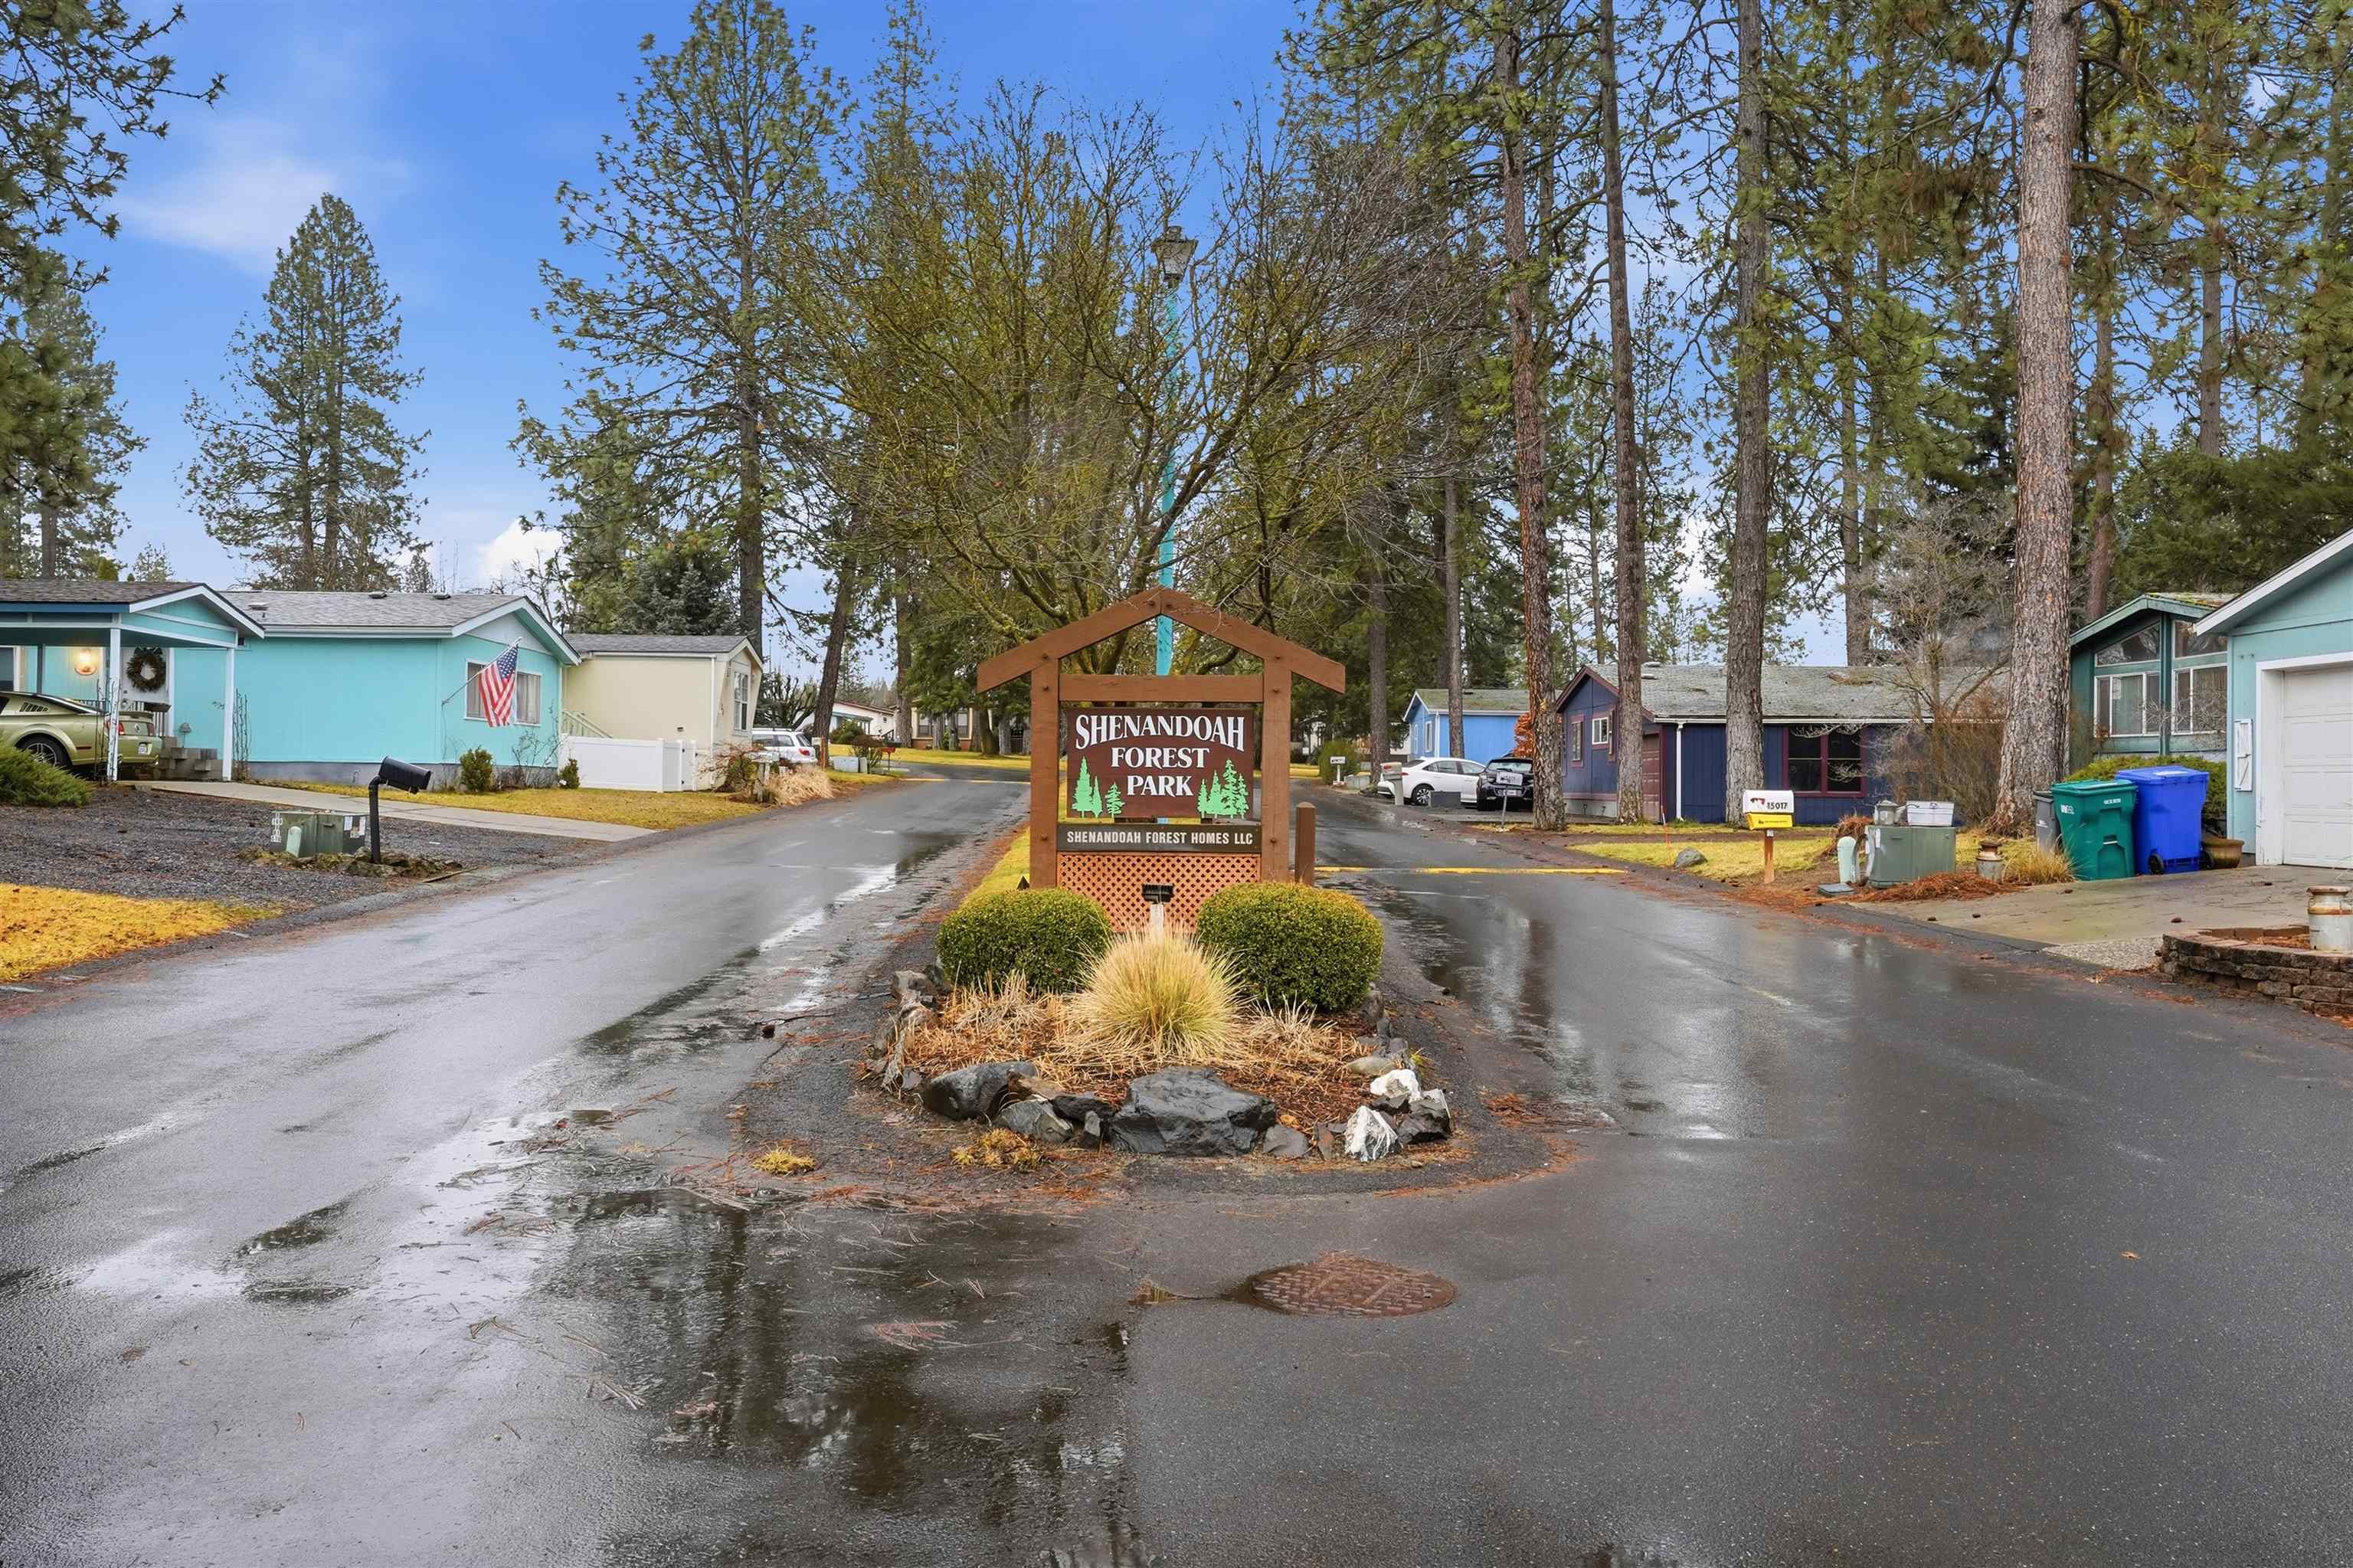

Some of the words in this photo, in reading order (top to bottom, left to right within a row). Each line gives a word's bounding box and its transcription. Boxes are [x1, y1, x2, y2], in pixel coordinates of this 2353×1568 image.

[1075, 714, 1245, 751] SHENANDOAH
[1111, 748, 1209, 769] FOREST
[1127, 775, 1193, 797] PARK
[1067, 831, 1141, 843] SHENANDOAH
[1146, 832, 1187, 844] FOREST
[1191, 833, 1229, 845] HOMES
[1234, 833, 1254, 846] LLC
